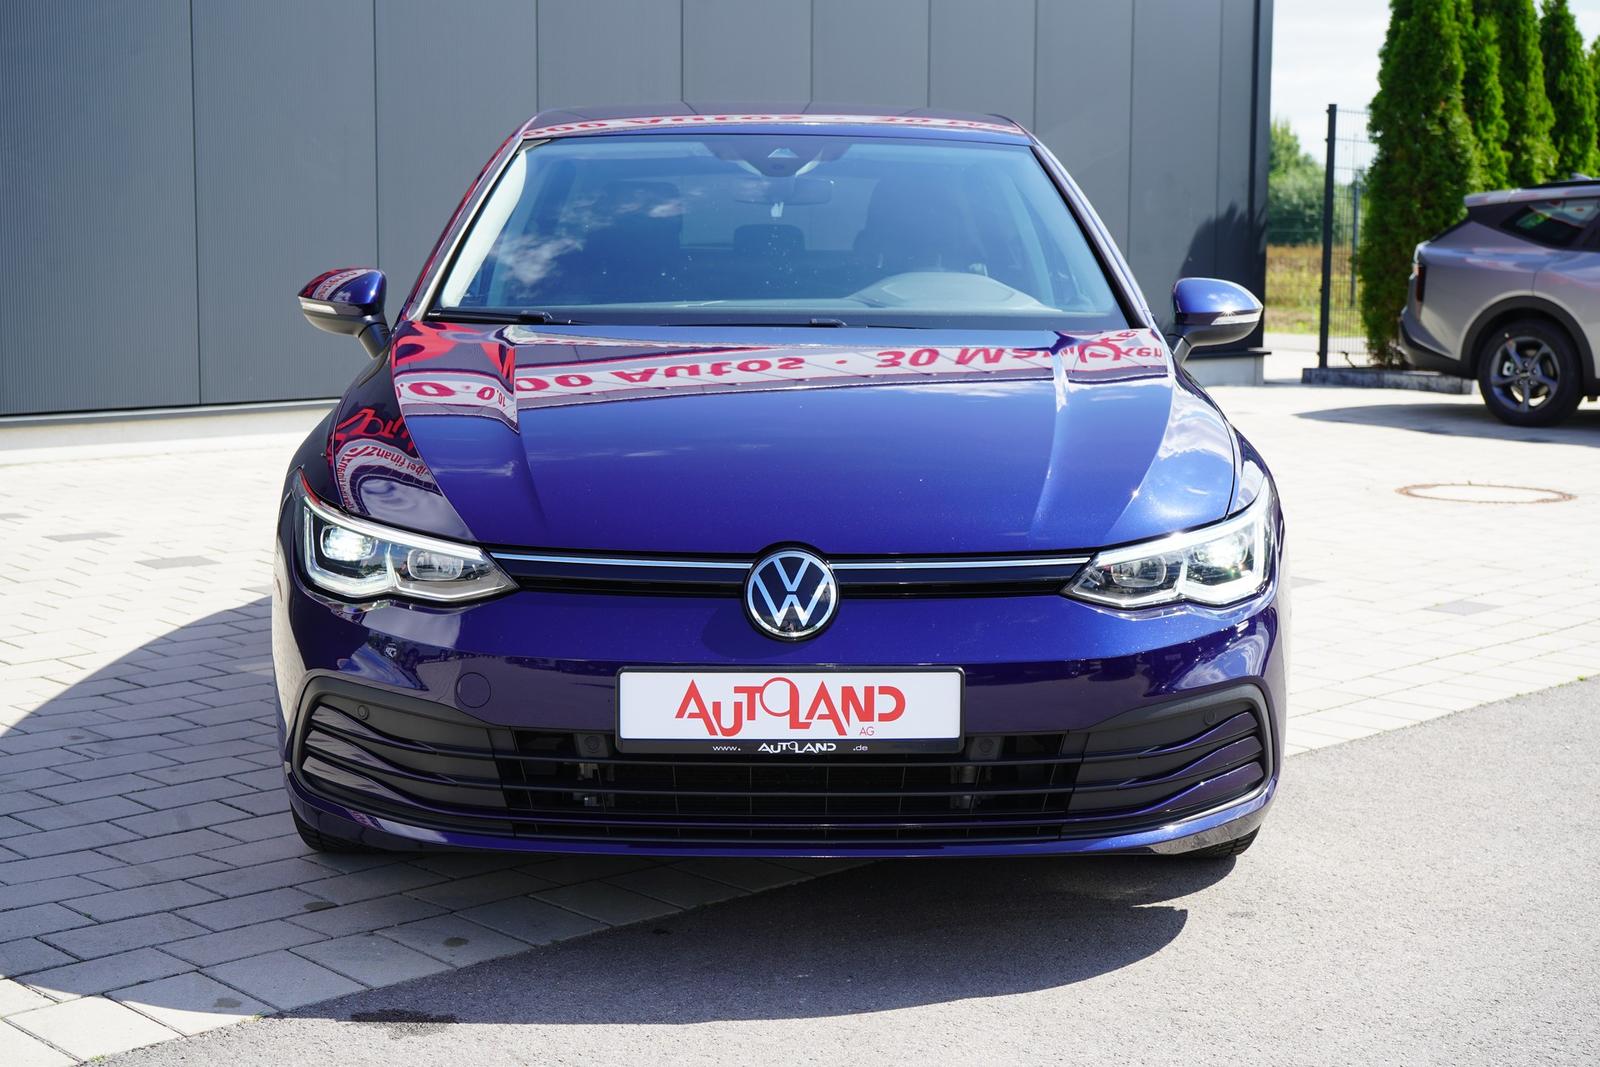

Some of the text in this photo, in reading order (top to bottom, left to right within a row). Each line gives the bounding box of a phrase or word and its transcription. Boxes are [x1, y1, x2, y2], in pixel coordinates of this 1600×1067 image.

[749, 551, 837, 636] VW
[675, 676, 906, 737] AUTOLAND
[712, 740, 869, 754] www. AUTOLAND .de
[859, 725, 875, 737] AG
